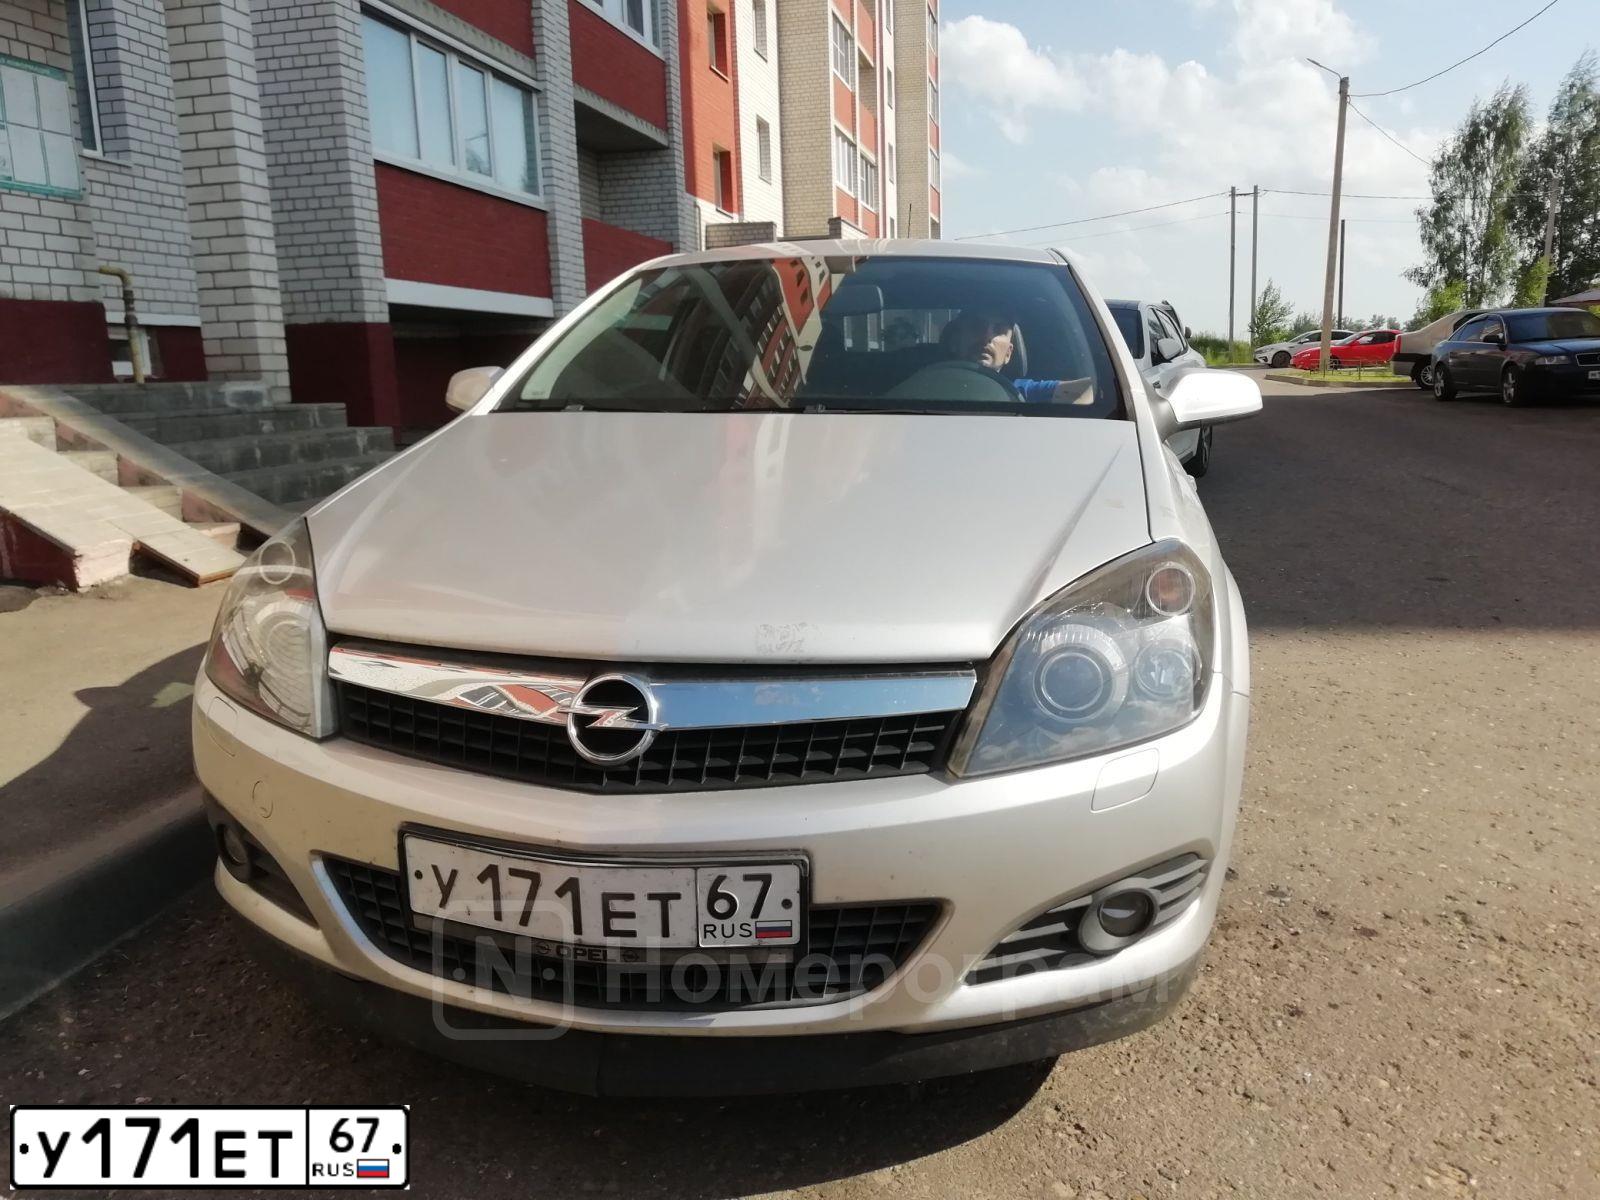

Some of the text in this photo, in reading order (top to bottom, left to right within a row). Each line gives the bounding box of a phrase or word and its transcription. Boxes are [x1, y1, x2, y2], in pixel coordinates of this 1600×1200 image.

[705, 873, 773, 920] 67
[703, 922, 753, 940] RUS
[555, 945, 617, 963] OPEL
